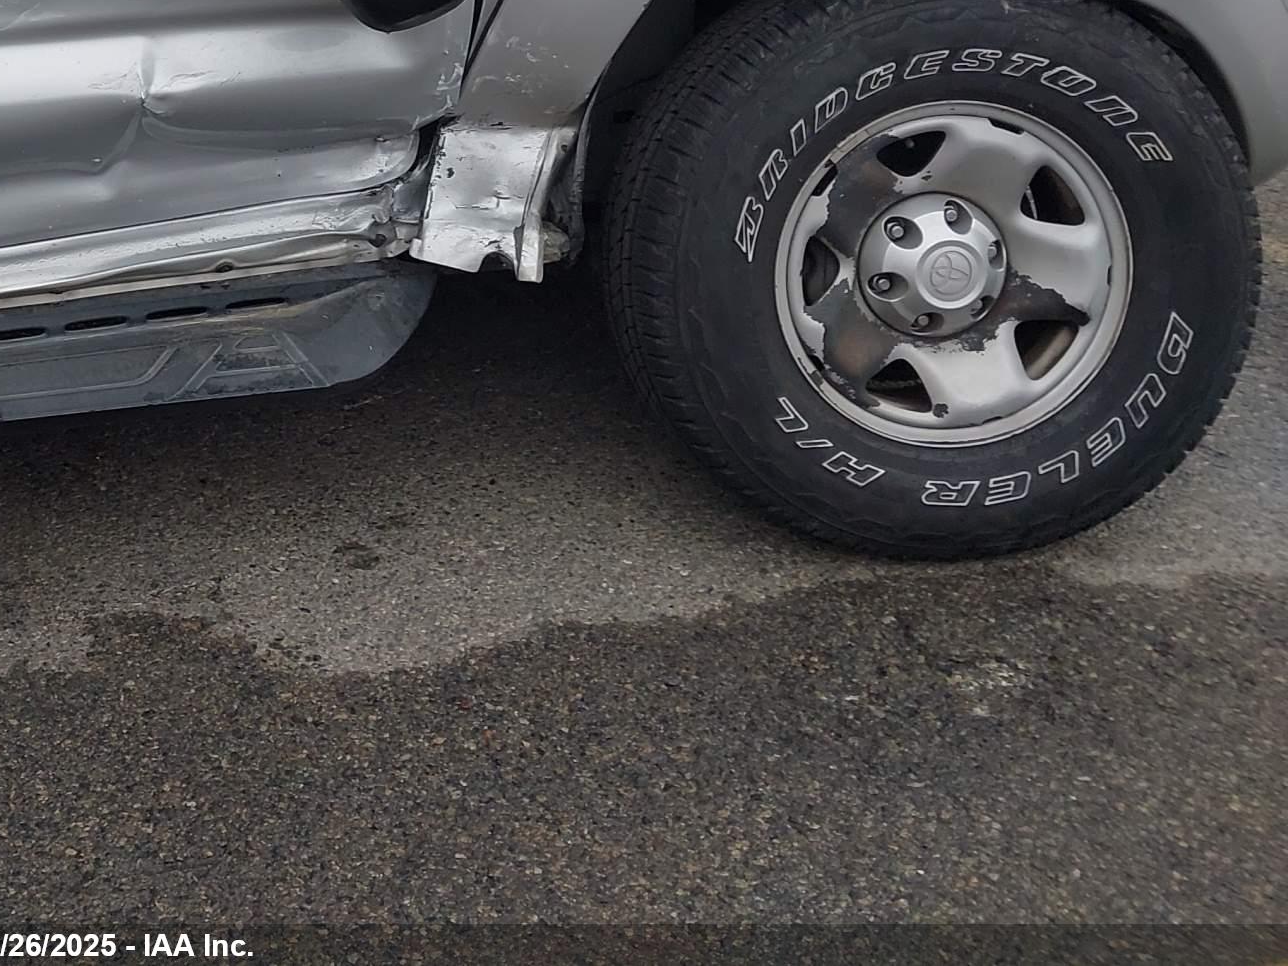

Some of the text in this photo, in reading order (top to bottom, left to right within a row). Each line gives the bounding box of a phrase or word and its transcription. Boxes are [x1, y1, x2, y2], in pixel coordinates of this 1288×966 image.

[733, 48, 1175, 262] BRIDGESTONE
[772, 310, 1195, 507] DUELER H/L
